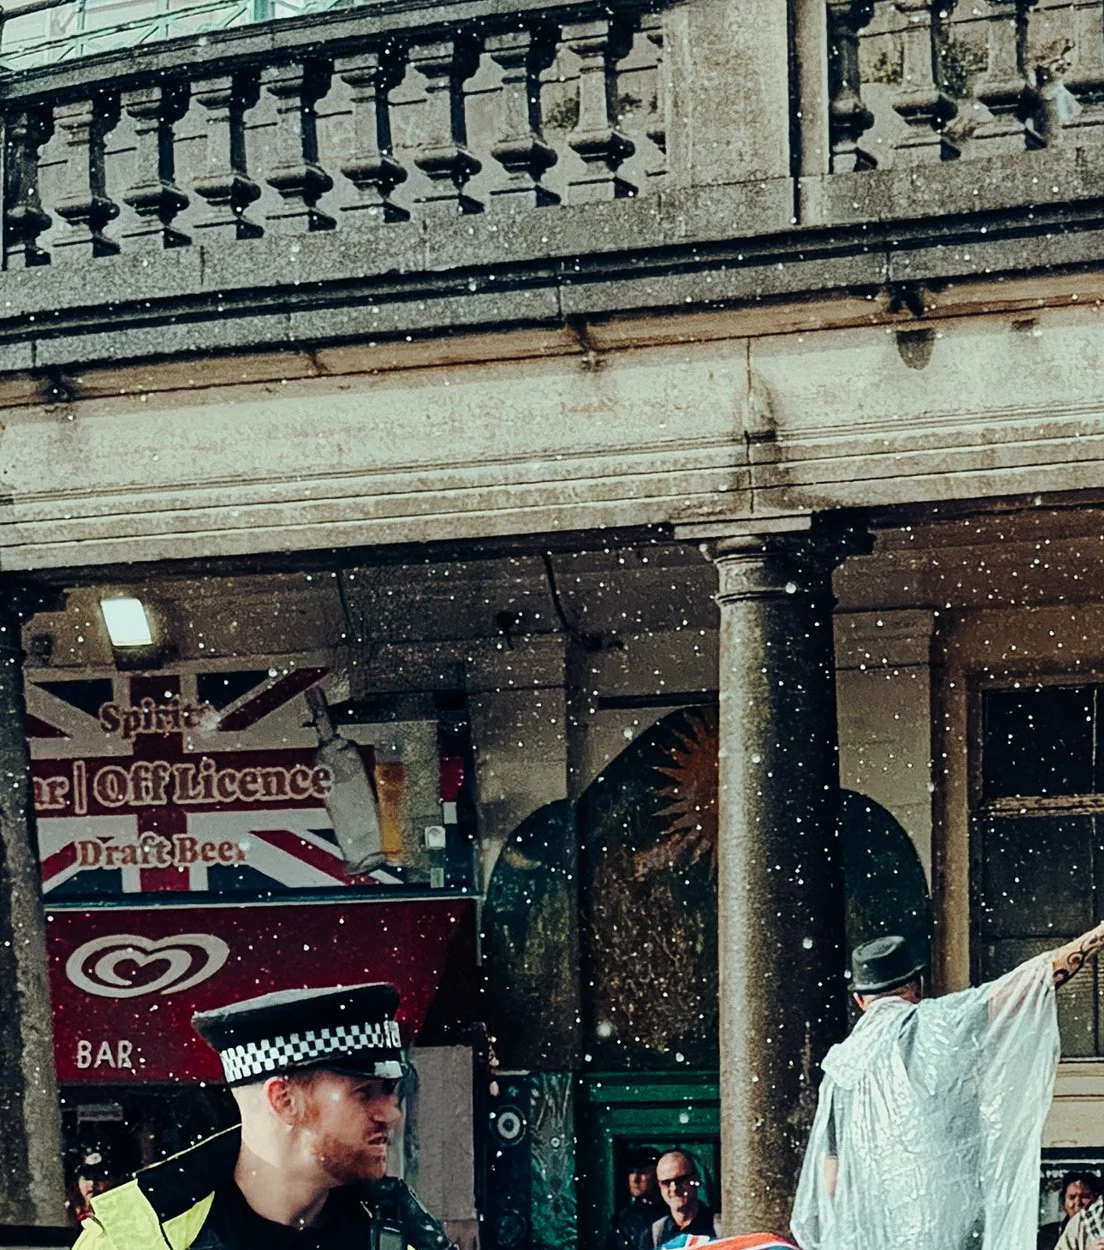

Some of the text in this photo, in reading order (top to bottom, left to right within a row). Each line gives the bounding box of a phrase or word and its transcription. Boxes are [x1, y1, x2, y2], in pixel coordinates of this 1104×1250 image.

[99, 697, 219, 742] Spirit
[94, 761, 171, 807] Off
[173, 759, 333, 804] Licence
[77, 832, 171, 870] Draft
[77, 1040, 133, 1068] BAR
